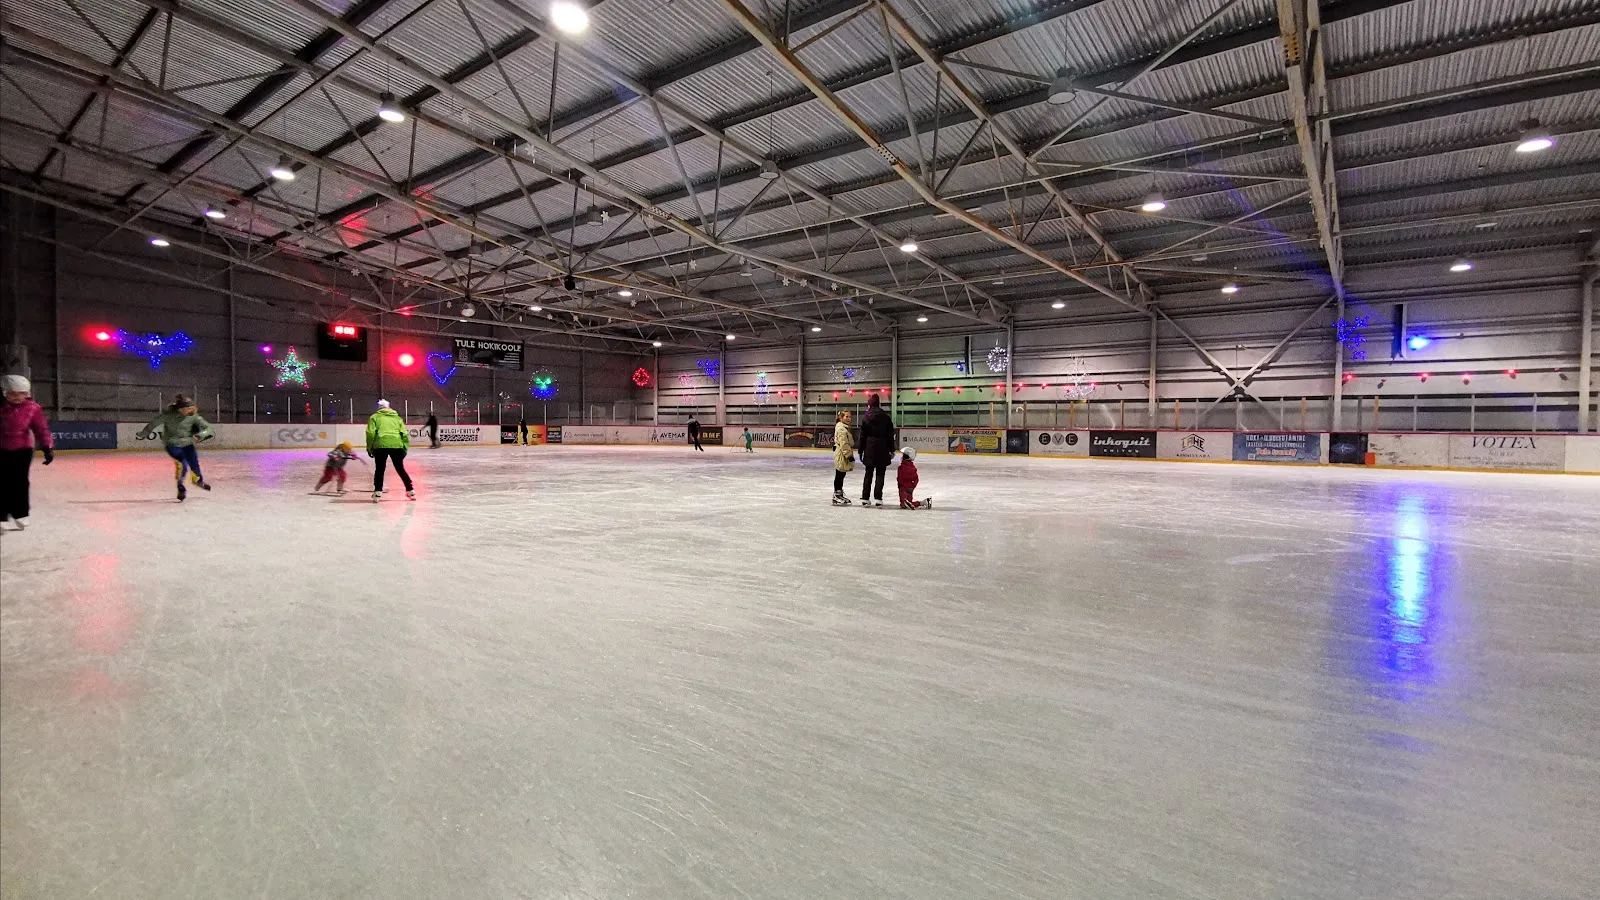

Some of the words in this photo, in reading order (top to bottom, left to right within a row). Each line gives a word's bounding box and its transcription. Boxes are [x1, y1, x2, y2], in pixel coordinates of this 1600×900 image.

[455, 339, 475, 349] TULE
[51, 432, 110, 440] ETCENTER
[1038, 433, 1078, 446] EVE
[1093, 436, 1151, 449] inkognit
[1472, 437, 1539, 449] VOTEX
